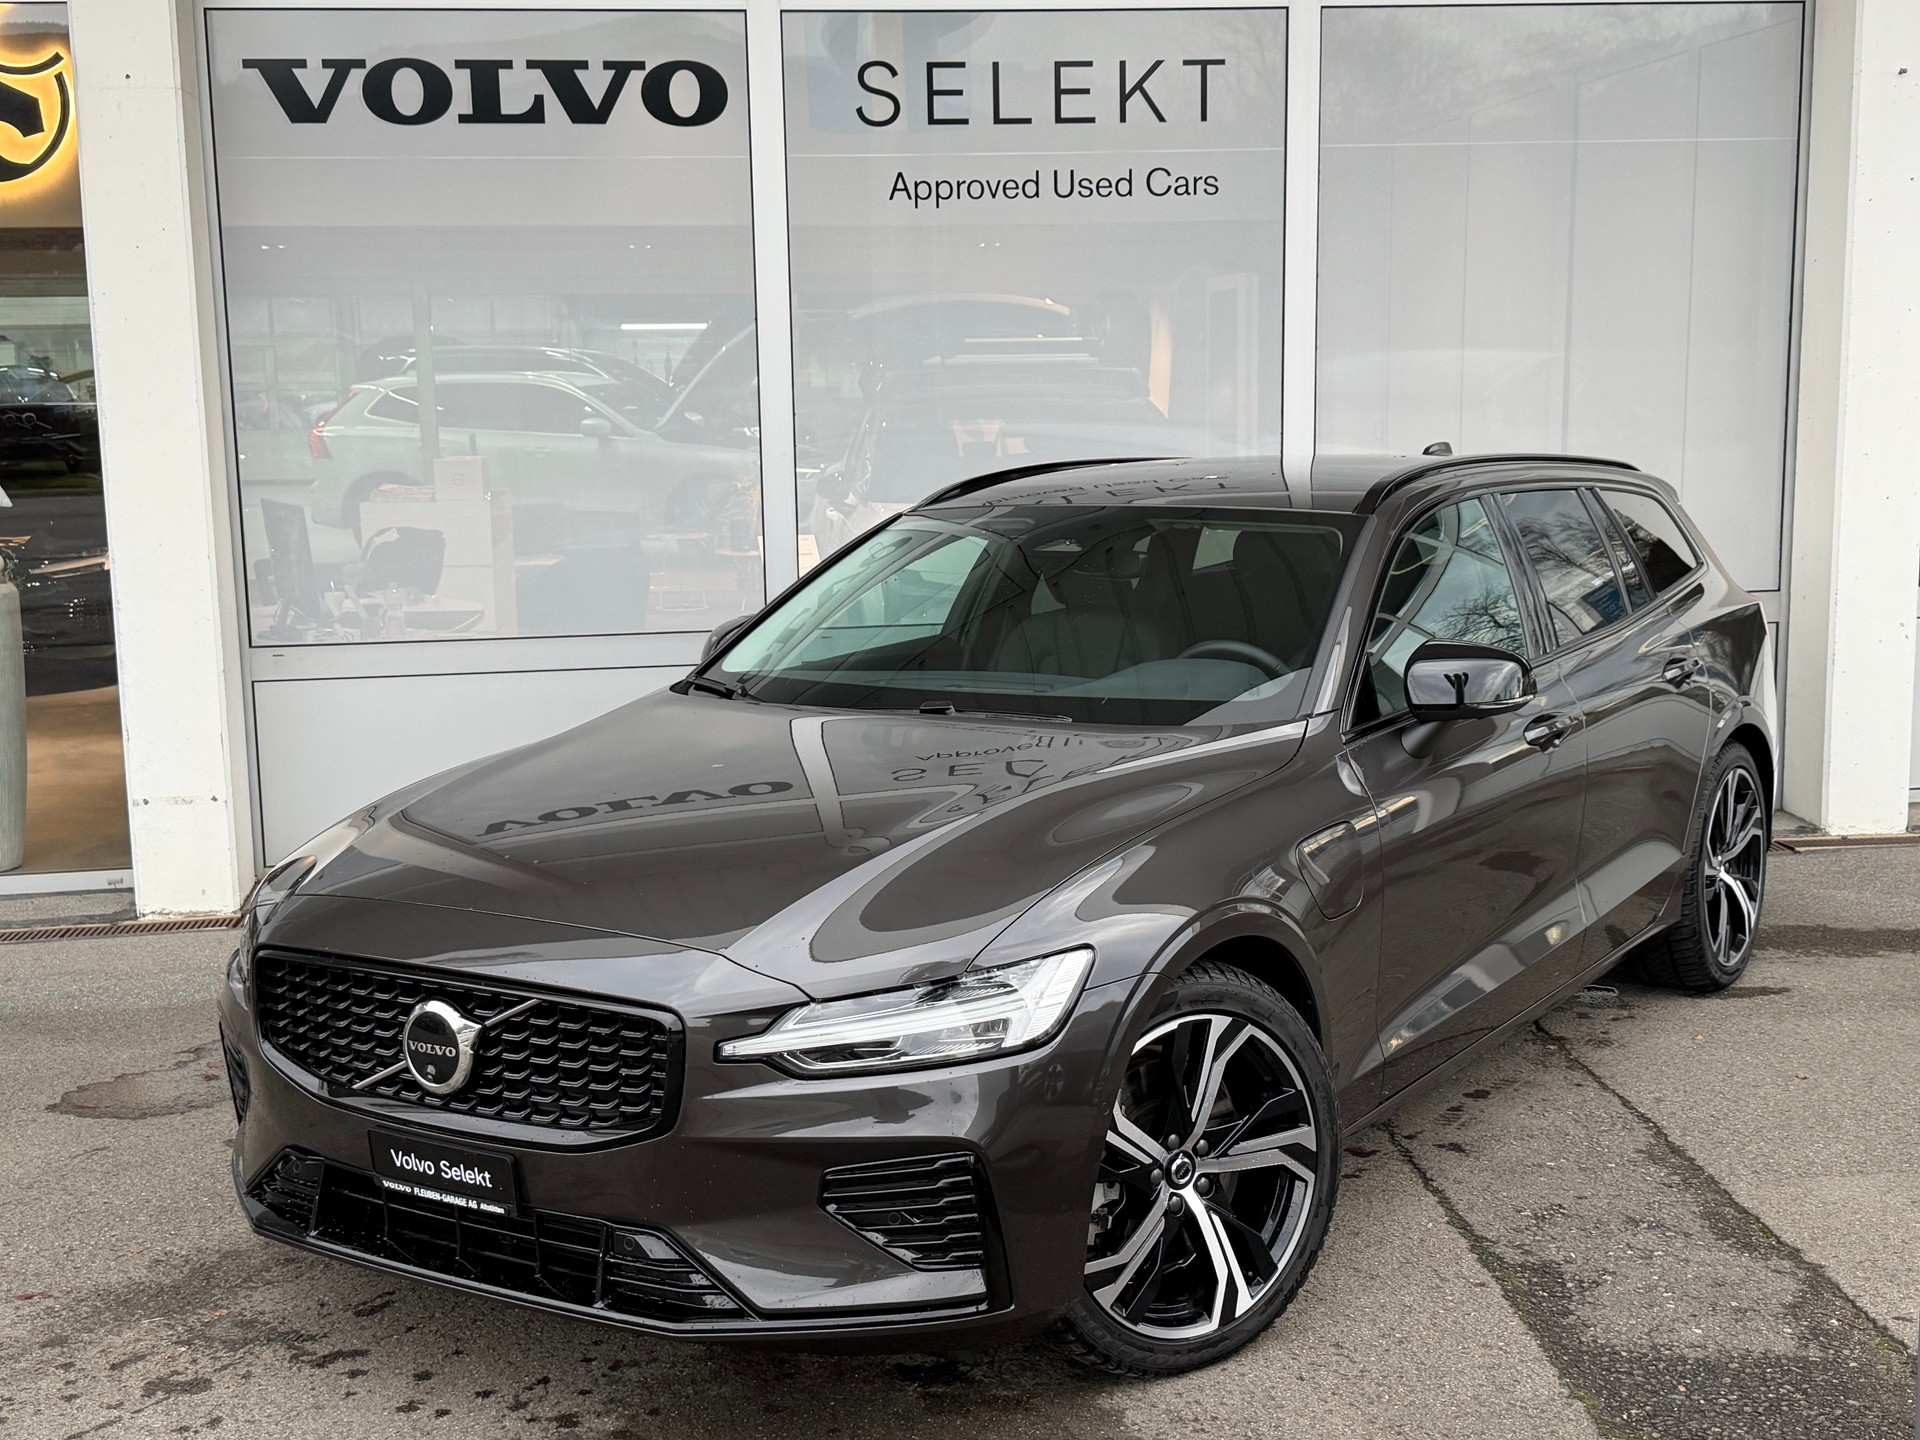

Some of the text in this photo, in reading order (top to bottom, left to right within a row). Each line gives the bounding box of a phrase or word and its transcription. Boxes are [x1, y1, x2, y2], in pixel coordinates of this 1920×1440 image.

[241, 57, 729, 127] VOLVO
[855, 58, 1226, 127] SELEKT
[889, 167, 1219, 208] Approved Used Cars
[408, 1040, 457, 1057] VOLVO
[390, 1148, 493, 1188] Volvo Selekt
[382, 1180, 412, 1192] VOLVO
[468, 1199, 478, 1209] AG
